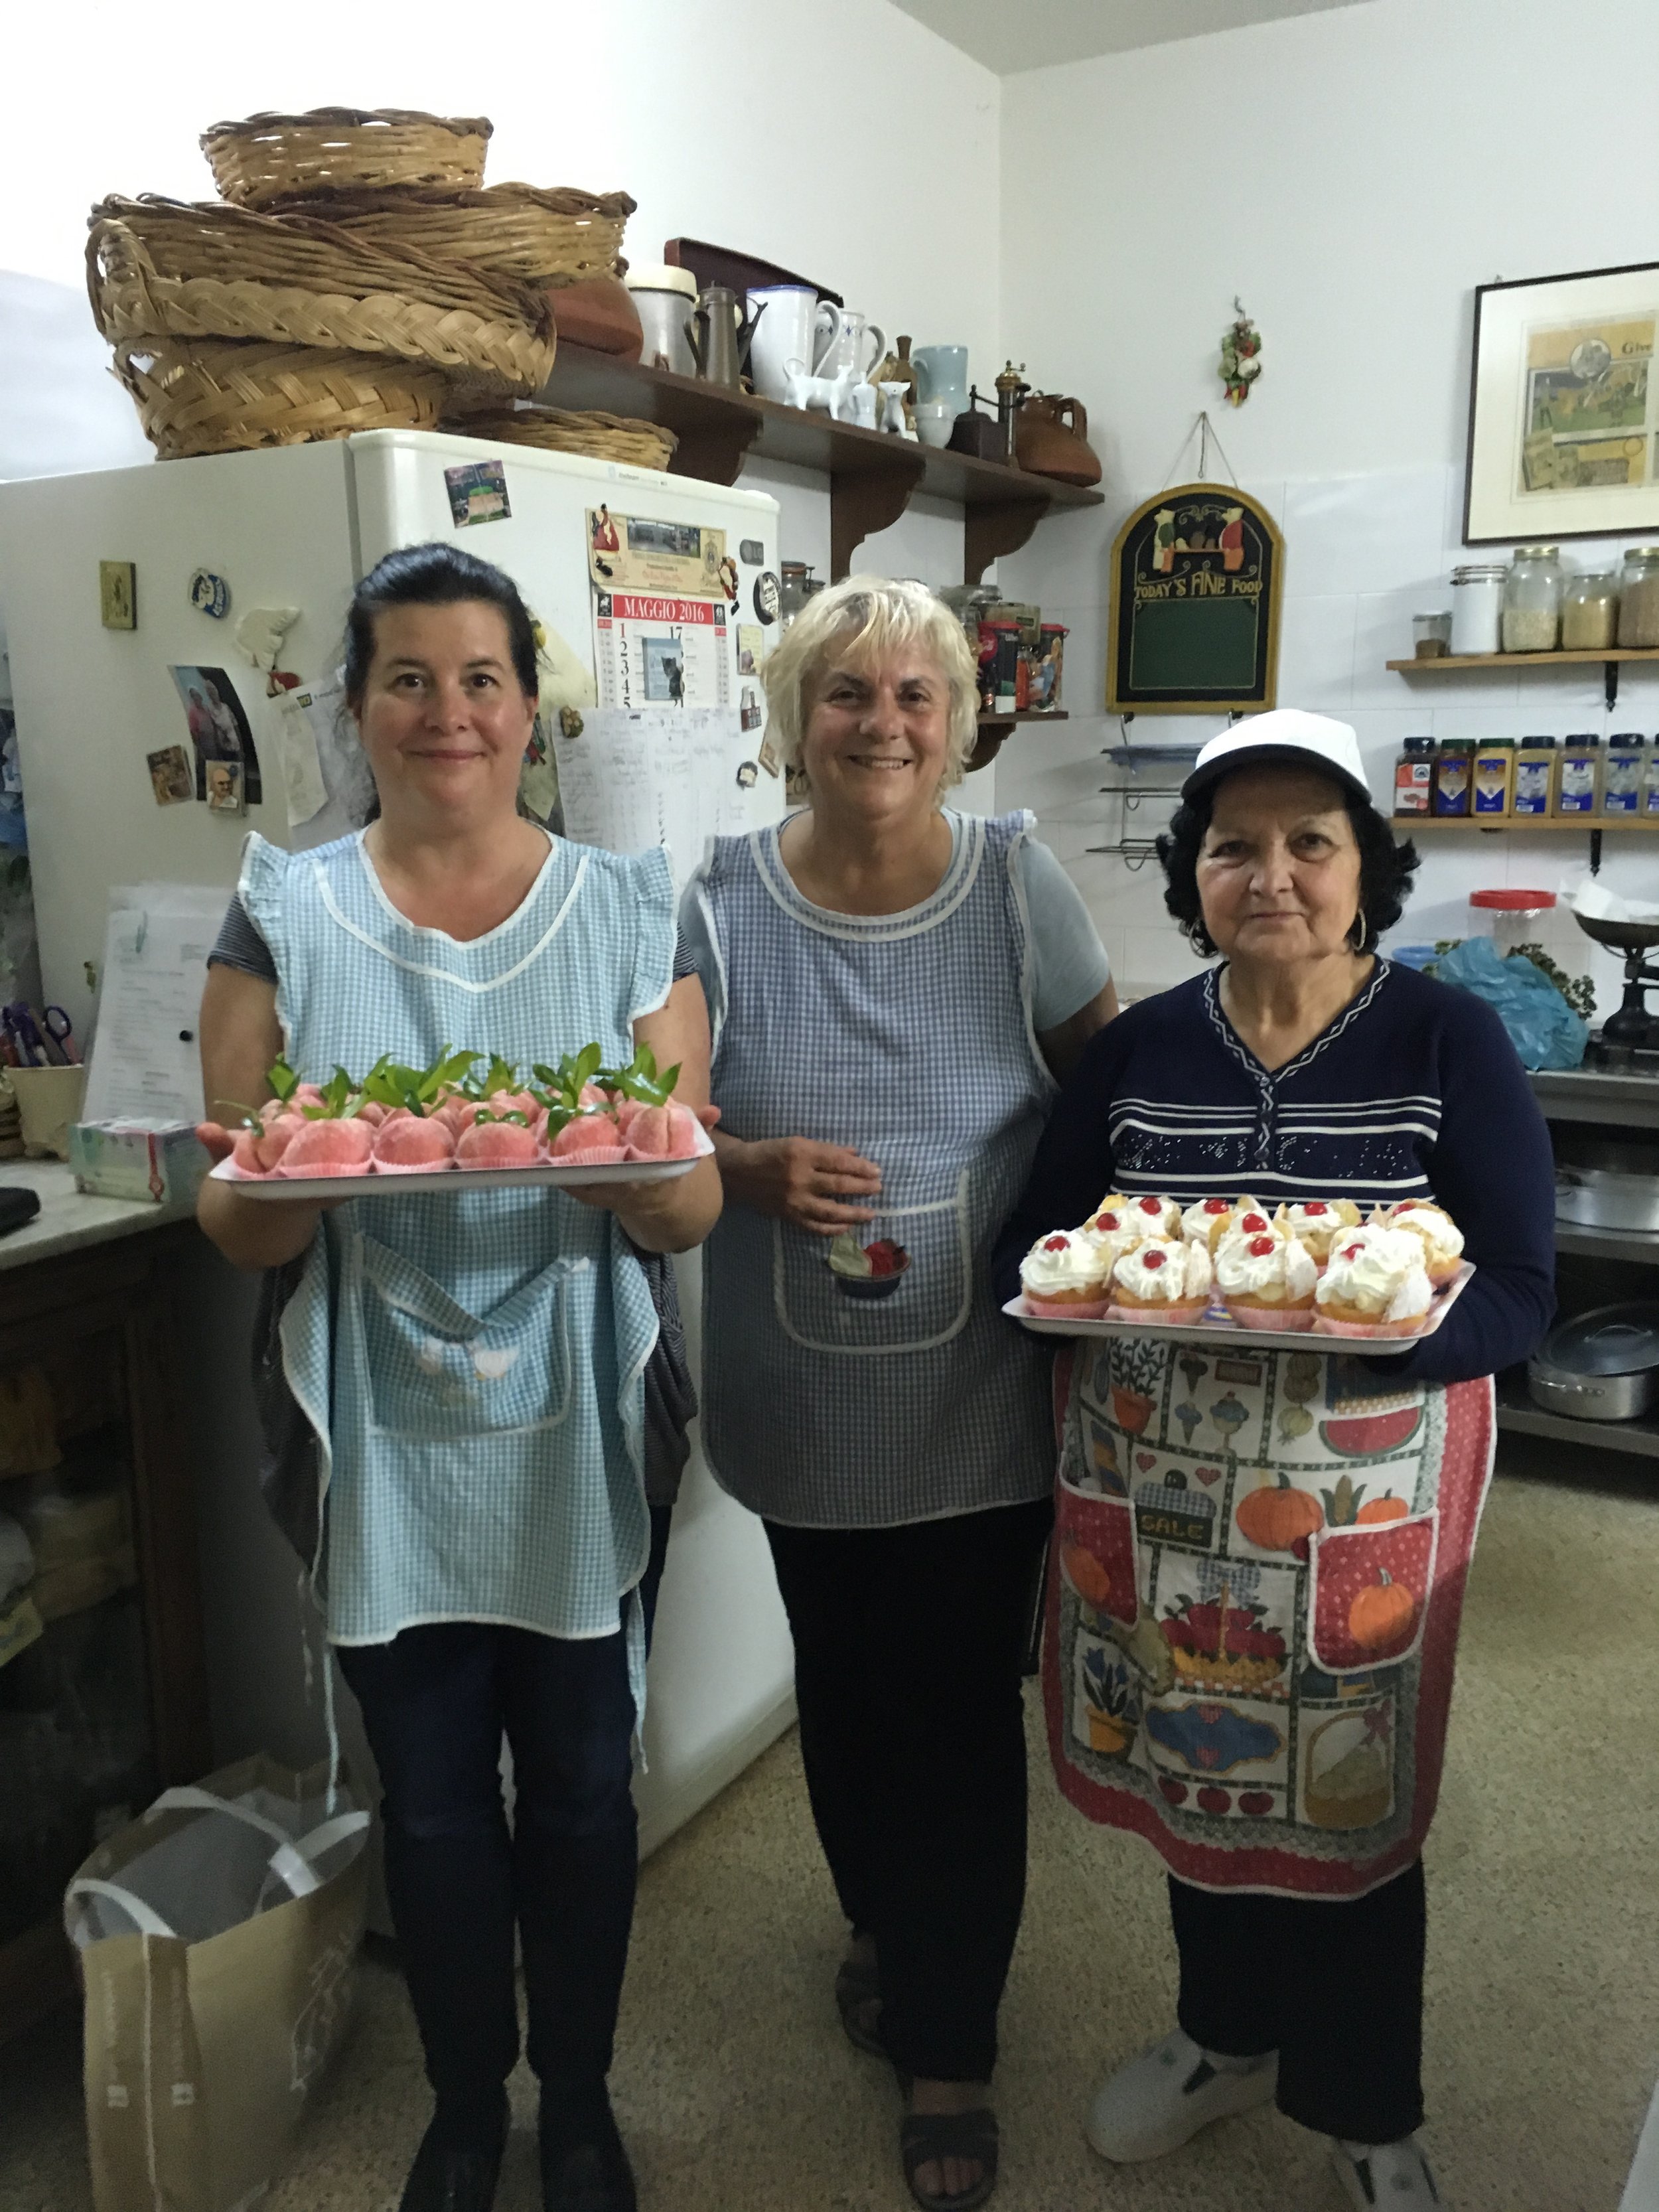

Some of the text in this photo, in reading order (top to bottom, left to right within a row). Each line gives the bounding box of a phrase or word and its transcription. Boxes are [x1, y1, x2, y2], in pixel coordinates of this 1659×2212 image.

[1135, 571, 1263, 599] TODAY'S FINE FOOD
[624, 597, 705, 623] MAGGIO 2016
[619, 623, 626, 638] 1
[619, 640, 628, 657] 2
[620, 659, 629, 676] 3
[621, 678, 630, 694] 4
[1141, 1514, 1204, 1540] SALE
